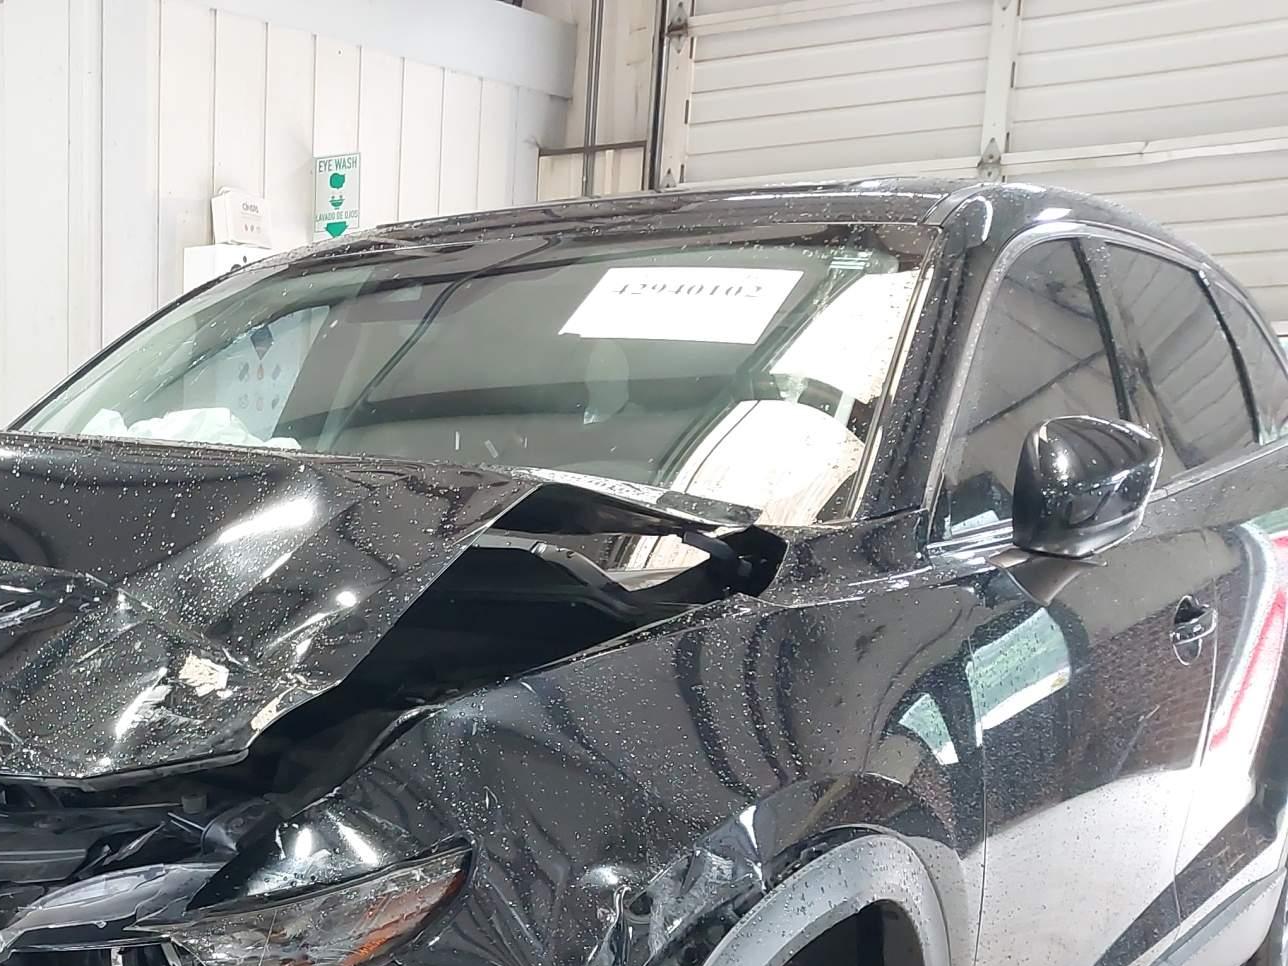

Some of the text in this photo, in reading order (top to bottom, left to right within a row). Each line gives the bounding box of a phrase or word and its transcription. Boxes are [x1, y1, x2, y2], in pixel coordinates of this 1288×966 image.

[318, 156, 357, 173] EYE WASH
[336, 211, 343, 219] DE
